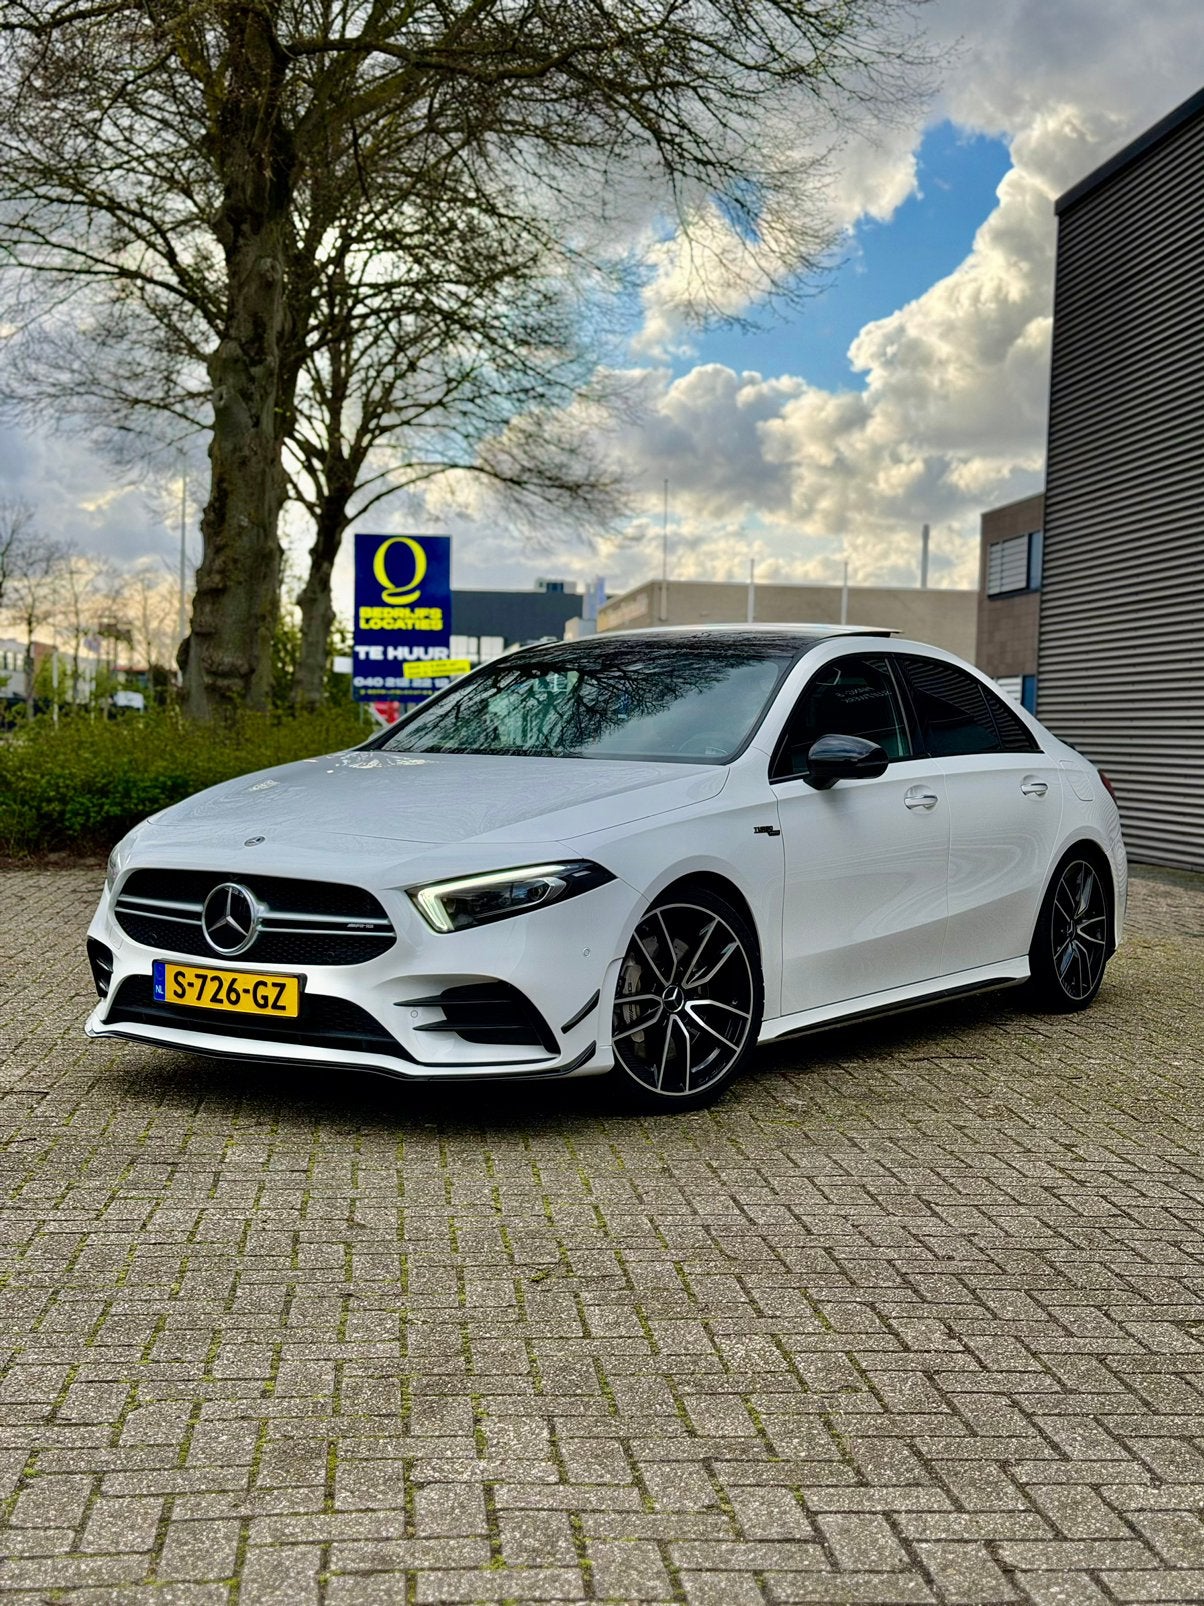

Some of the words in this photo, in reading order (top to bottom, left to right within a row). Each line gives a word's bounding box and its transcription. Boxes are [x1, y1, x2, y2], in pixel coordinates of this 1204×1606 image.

[359, 618, 444, 631] LOCATIES
[354, 645, 384, 660] TE
[386, 646, 450, 660] HUUR
[353, 676, 384, 687] 040
[155, 984, 164, 995] NL
[173, 970, 287, 1011] S-726-GZ
